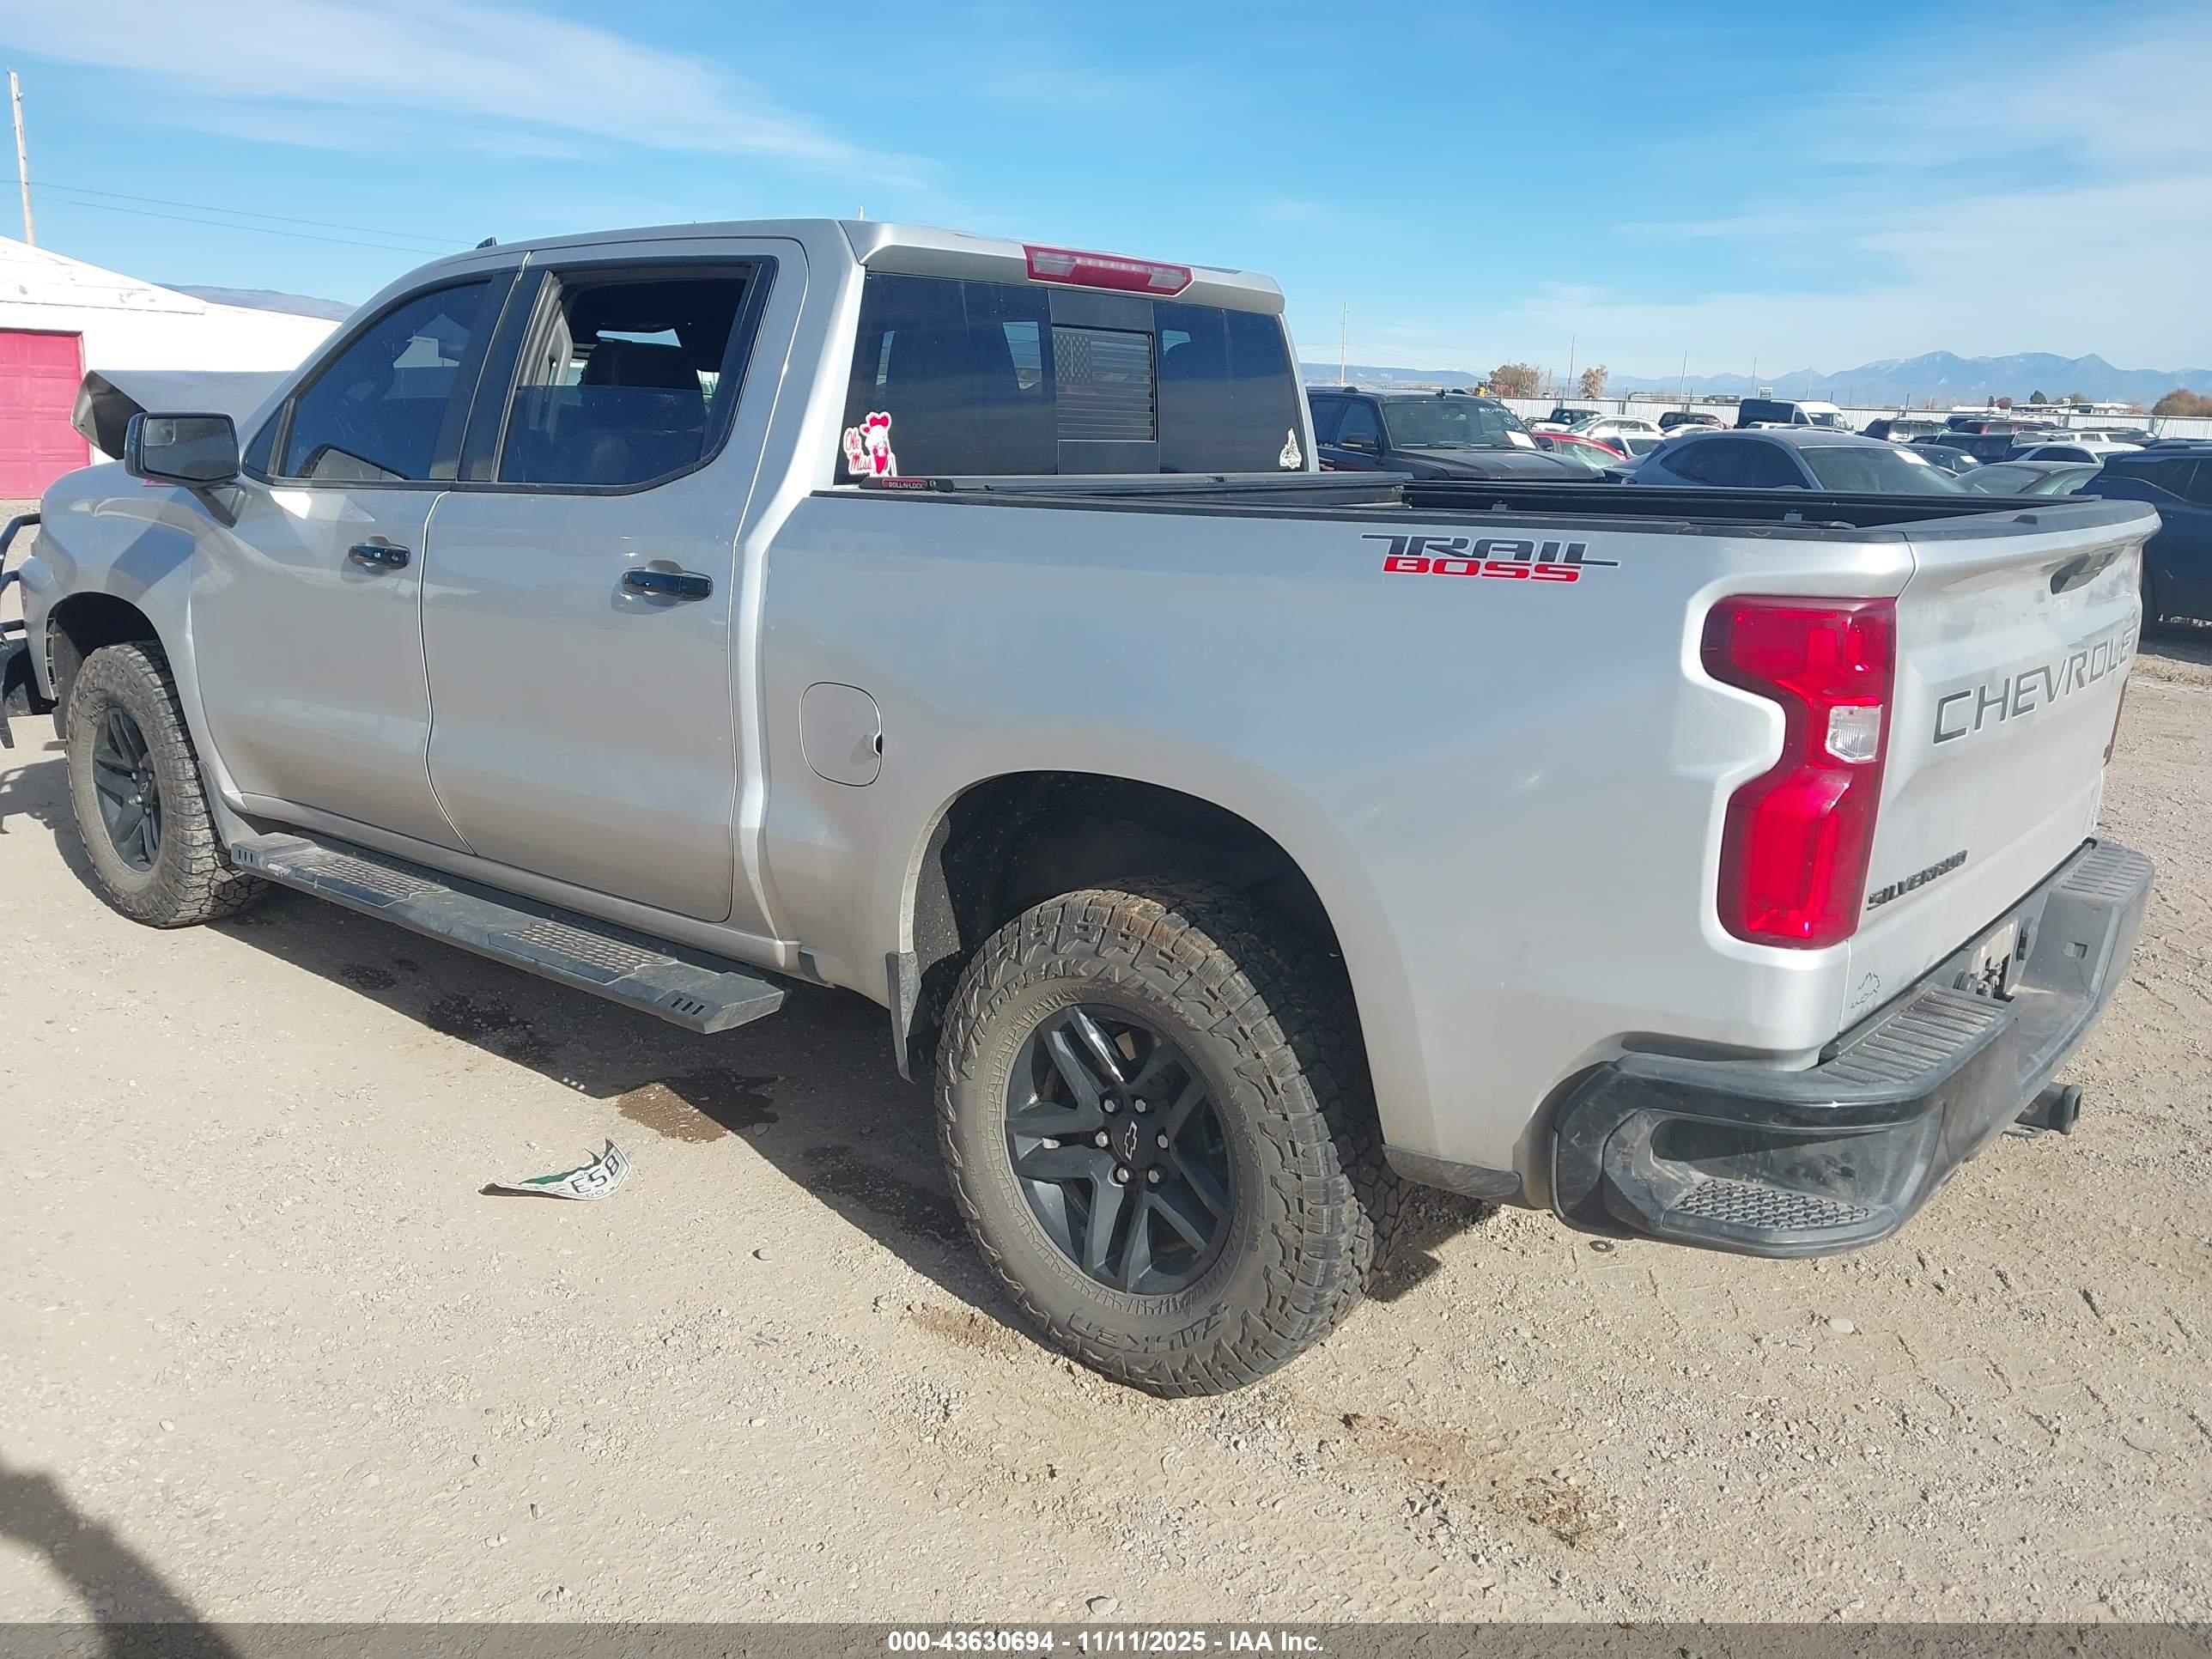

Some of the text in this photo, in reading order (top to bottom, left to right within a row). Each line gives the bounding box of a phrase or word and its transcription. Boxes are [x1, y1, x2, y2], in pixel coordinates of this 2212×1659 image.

[845, 428, 860, 451] Ole
[849, 453, 872, 471] Miss
[1361, 533, 1620, 568] TRAIL
[1383, 556, 1581, 582] BOSS
[1866, 849, 1968, 911] SILVERADO
